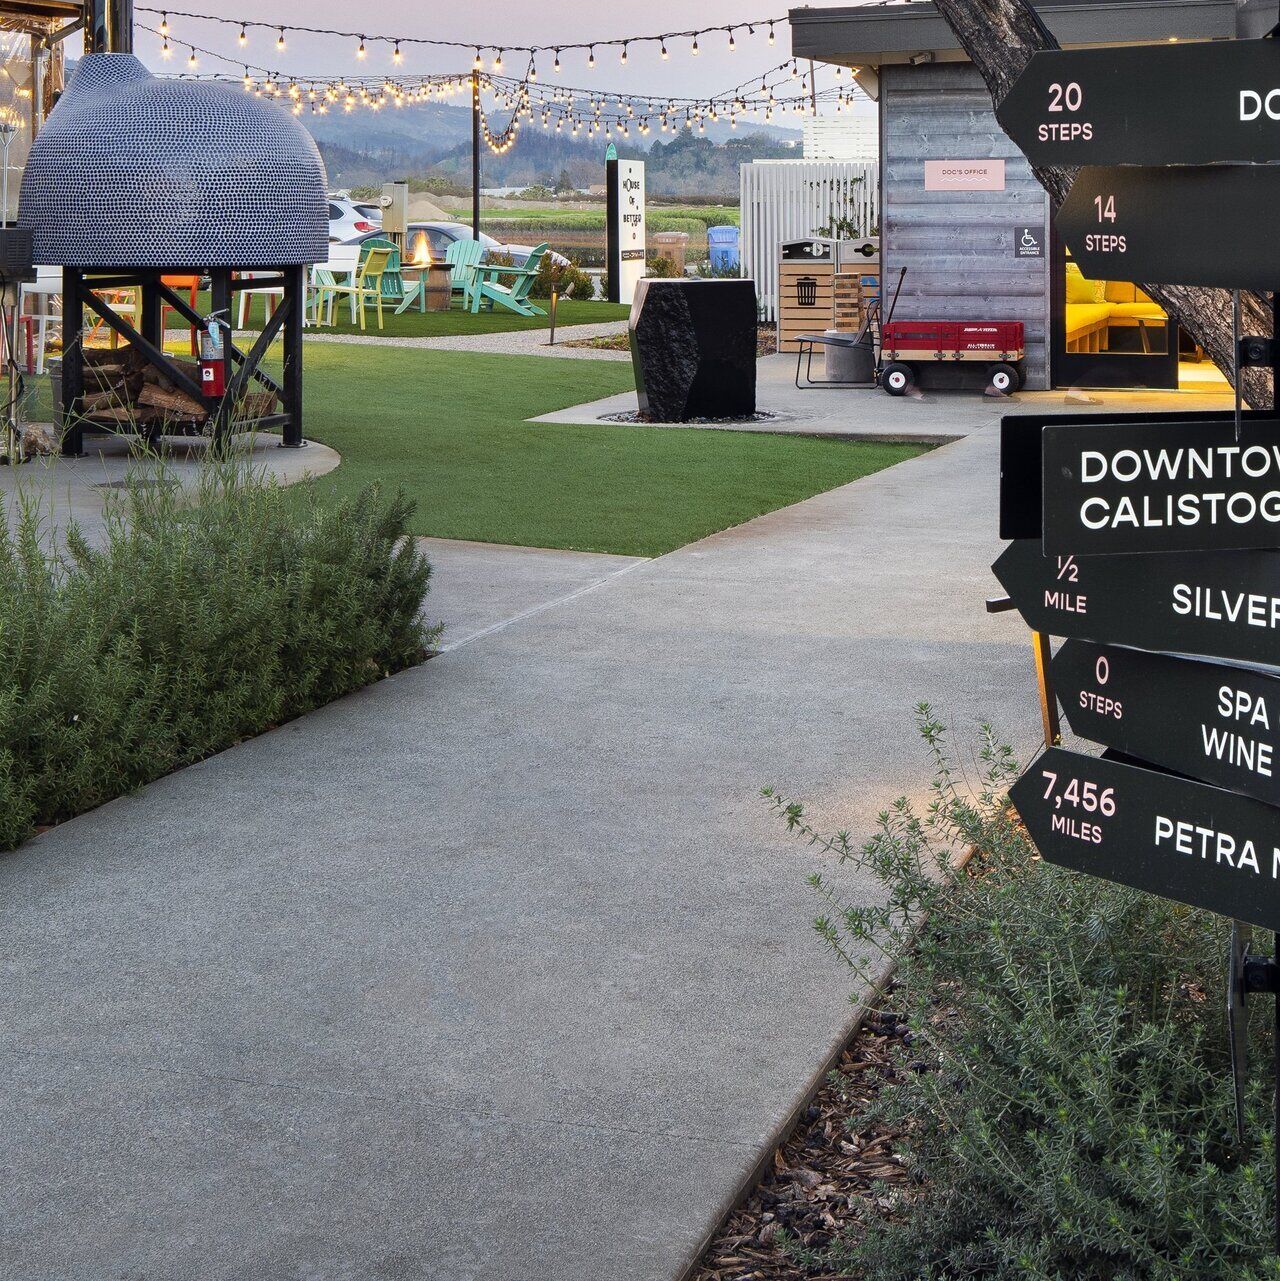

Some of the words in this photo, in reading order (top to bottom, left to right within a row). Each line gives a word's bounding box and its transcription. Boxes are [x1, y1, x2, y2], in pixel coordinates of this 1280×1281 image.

[1049, 83, 1082, 111] 20
[1039, 123, 1092, 141] STEPS
[622, 178, 640, 192] HOUSE
[1095, 196, 1116, 222] 14
[1086, 235, 1126, 252] STEPS
[1045, 591, 1086, 613] MILE
[1096, 656, 1109, 684] 0
[1080, 691, 1122, 719] STEPS
[1218, 686, 1269, 729] SPA
[1202, 725, 1273, 776] WINE
[1043, 771, 1115, 816] 7,456
[1052, 814, 1101, 843] MILES
[1156, 816, 1259, 873] PETRA
